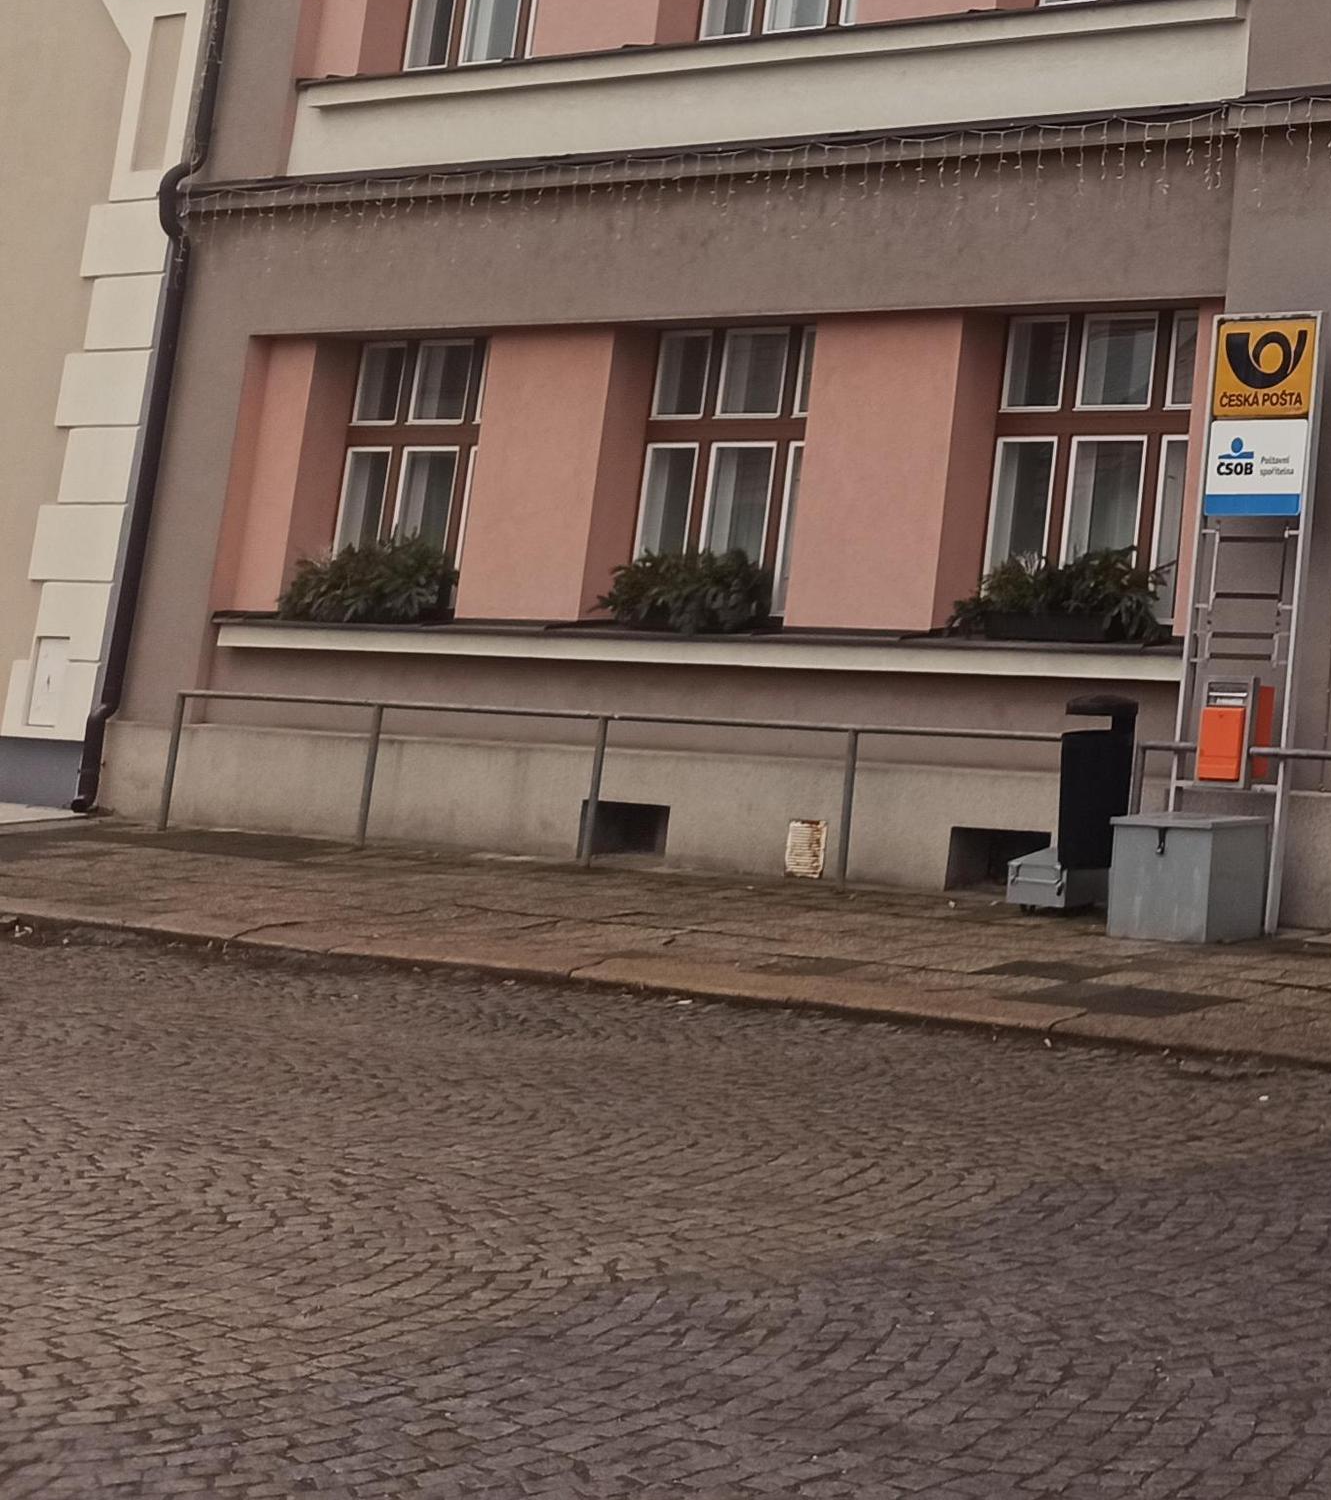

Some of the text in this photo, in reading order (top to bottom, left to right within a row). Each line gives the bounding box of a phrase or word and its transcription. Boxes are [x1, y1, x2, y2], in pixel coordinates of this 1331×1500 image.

[1219, 390, 1303, 408] ČESKÁ POŠTA
[1216, 462, 1254, 476] ČSOB
